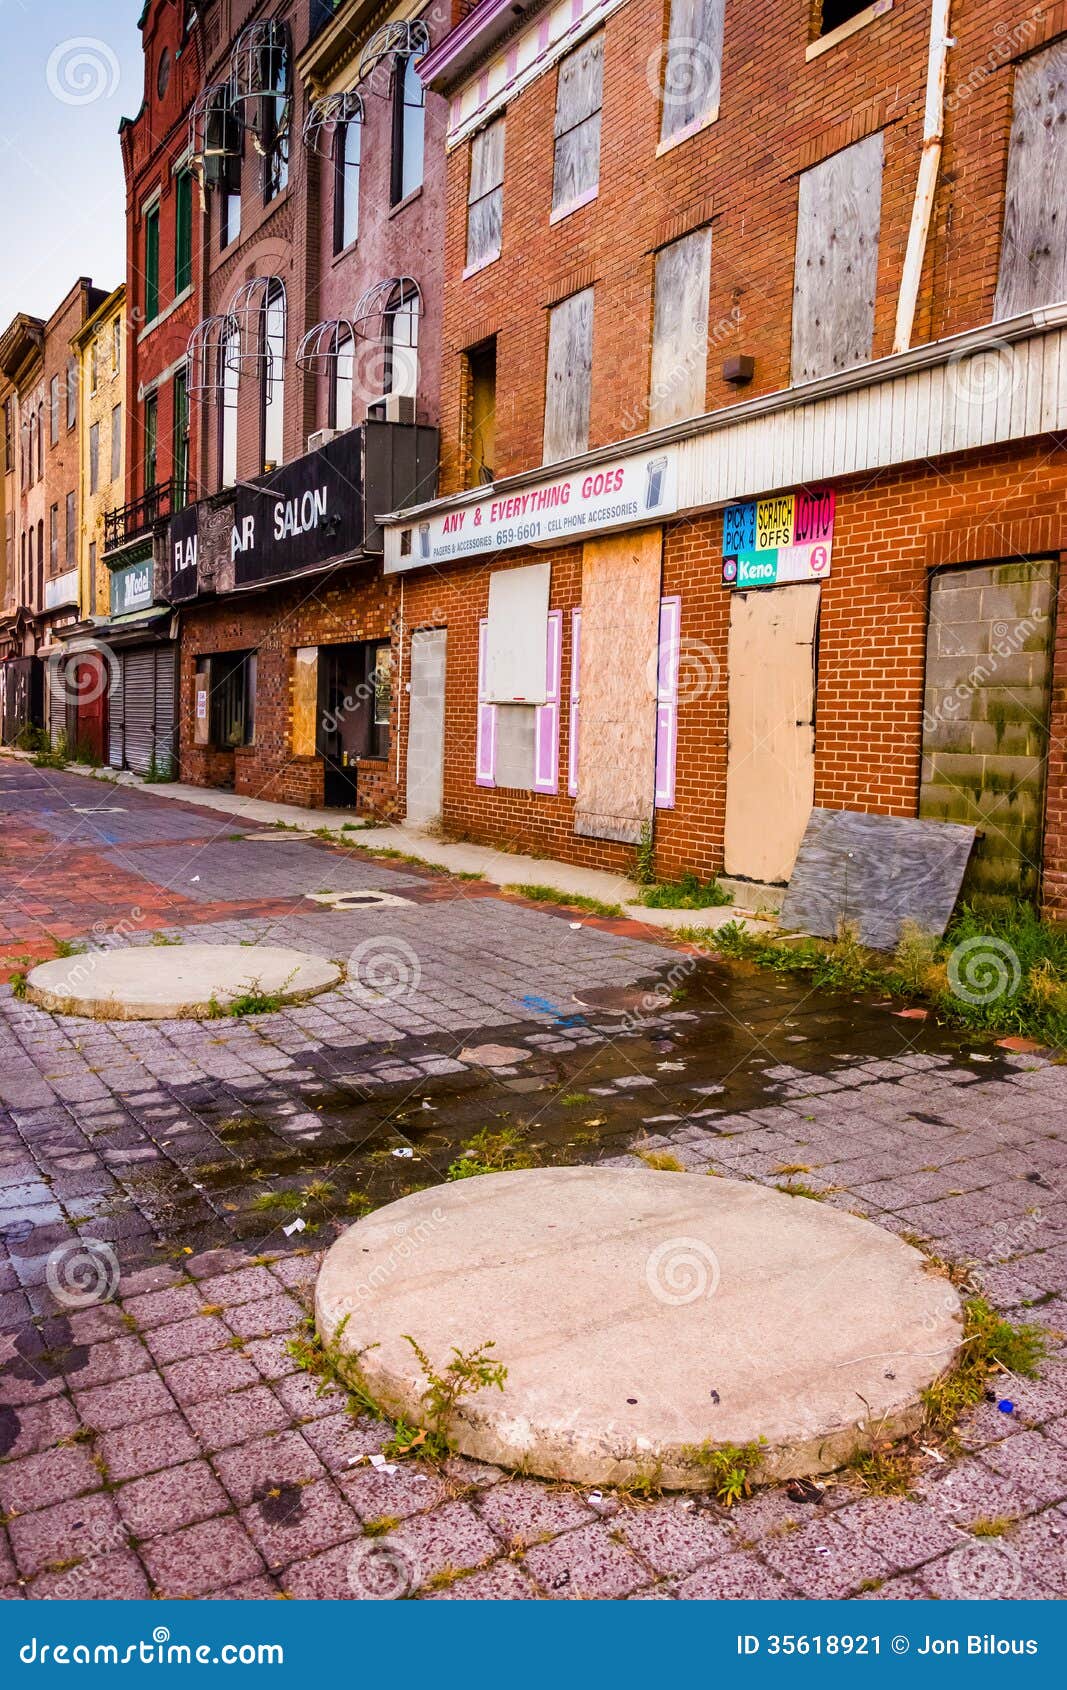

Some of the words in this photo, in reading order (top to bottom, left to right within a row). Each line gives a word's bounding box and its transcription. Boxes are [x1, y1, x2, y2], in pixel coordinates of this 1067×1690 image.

[274, 486, 328, 541] SALON
[442, 511, 466, 535] ANY
[473, 507, 483, 527] &
[490, 483, 571, 523] EVERYTHING
[581, 468, 625, 499] GOES
[726, 508, 746, 530] PICK
[749, 505, 755, 526] 3
[758, 499, 793, 531] SCRATCH
[796, 492, 831, 542] LOTTO
[433, 545, 451, 557] PAGERS
[457, 535, 492, 552] ACCESSORIES
[496, 521, 541, 546] 659-6601
[548, 519, 562, 532] CELL
[563, 513, 586, 529] PHONE
[588, 501, 638, 523] ACCESSORIES
[726, 529, 745, 551] PICK
[748, 528, 755, 548] 4
[760, 528, 790, 547] OFFS
[813, 548, 825, 569] 5
